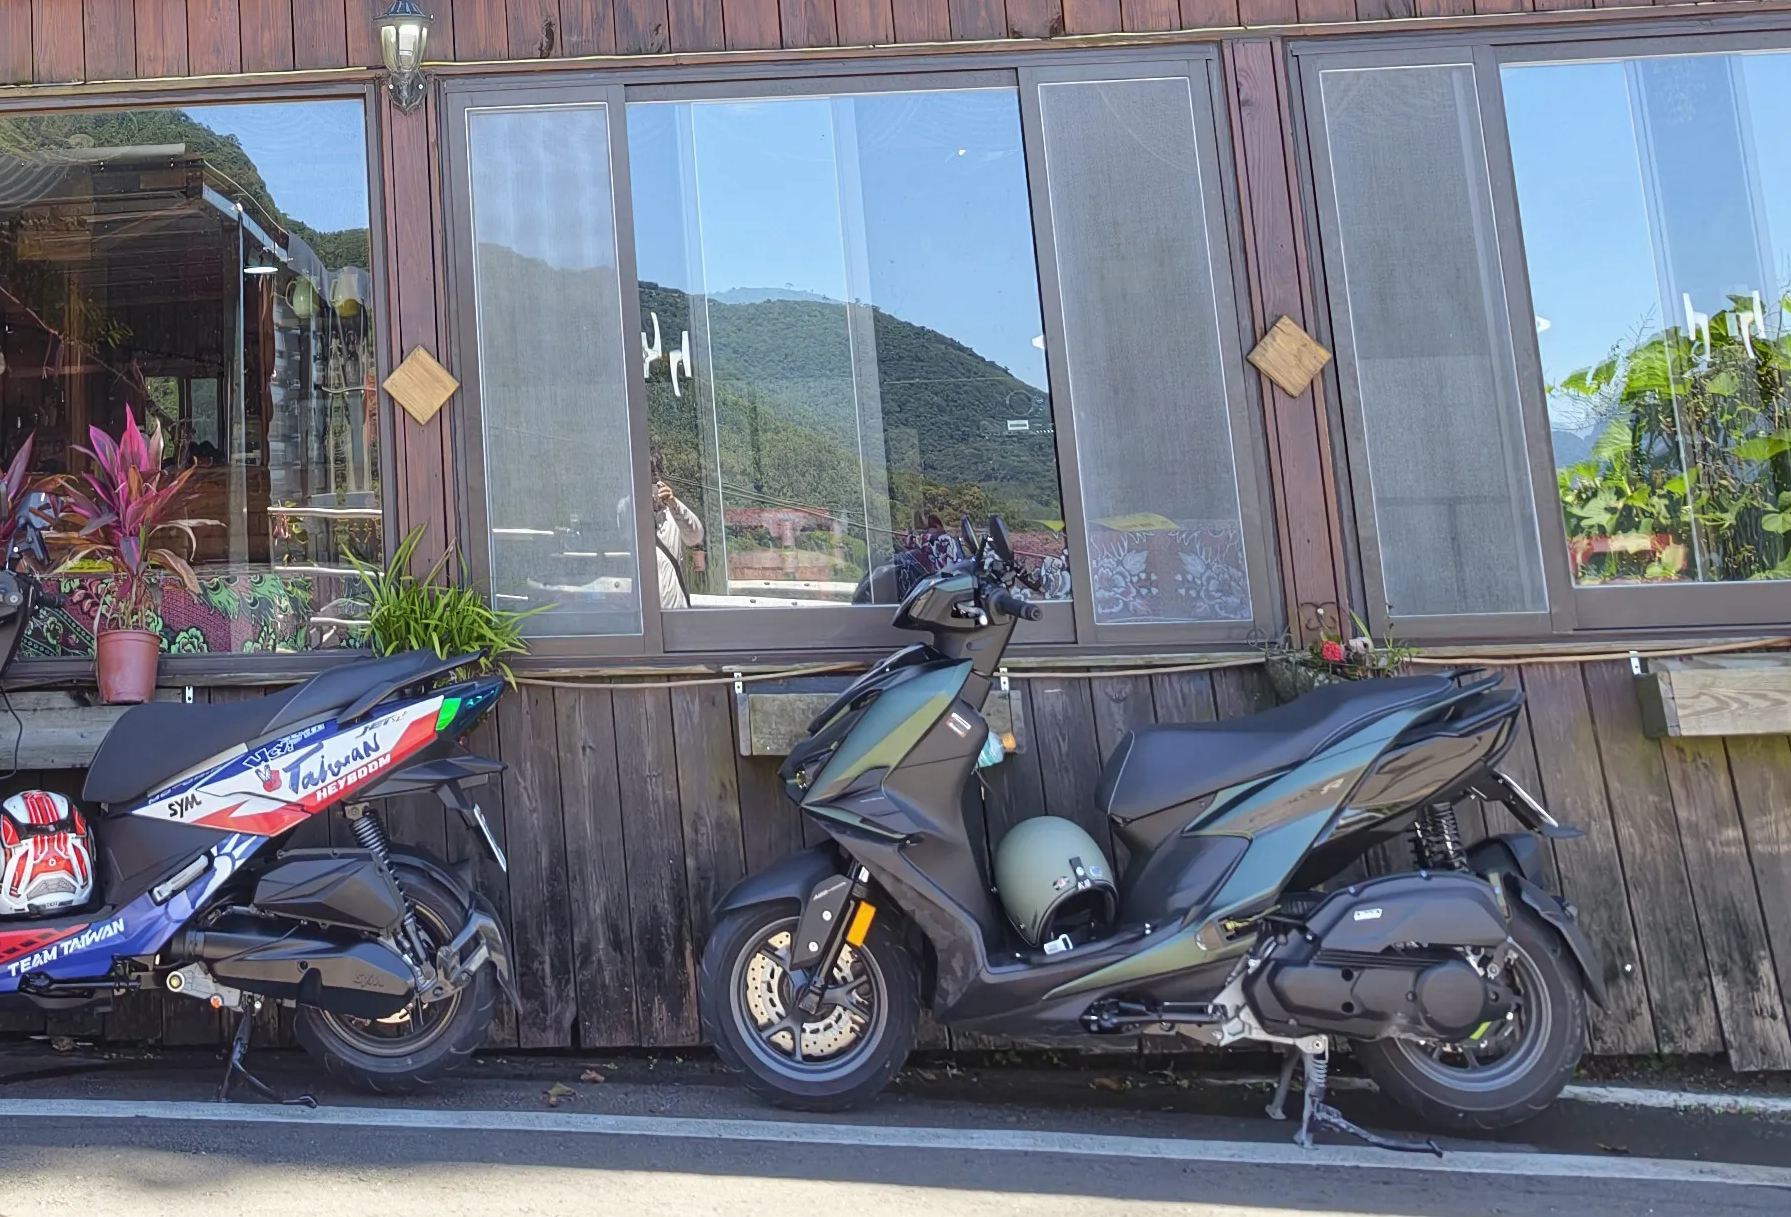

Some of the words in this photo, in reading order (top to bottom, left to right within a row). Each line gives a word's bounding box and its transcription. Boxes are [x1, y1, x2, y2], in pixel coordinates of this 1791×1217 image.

[315, 753, 391, 801] HEYBOOM
[167, 793, 203, 818] SYM
[7, 944, 58, 977] TEAM
[60, 918, 125, 957] TAIWAN
